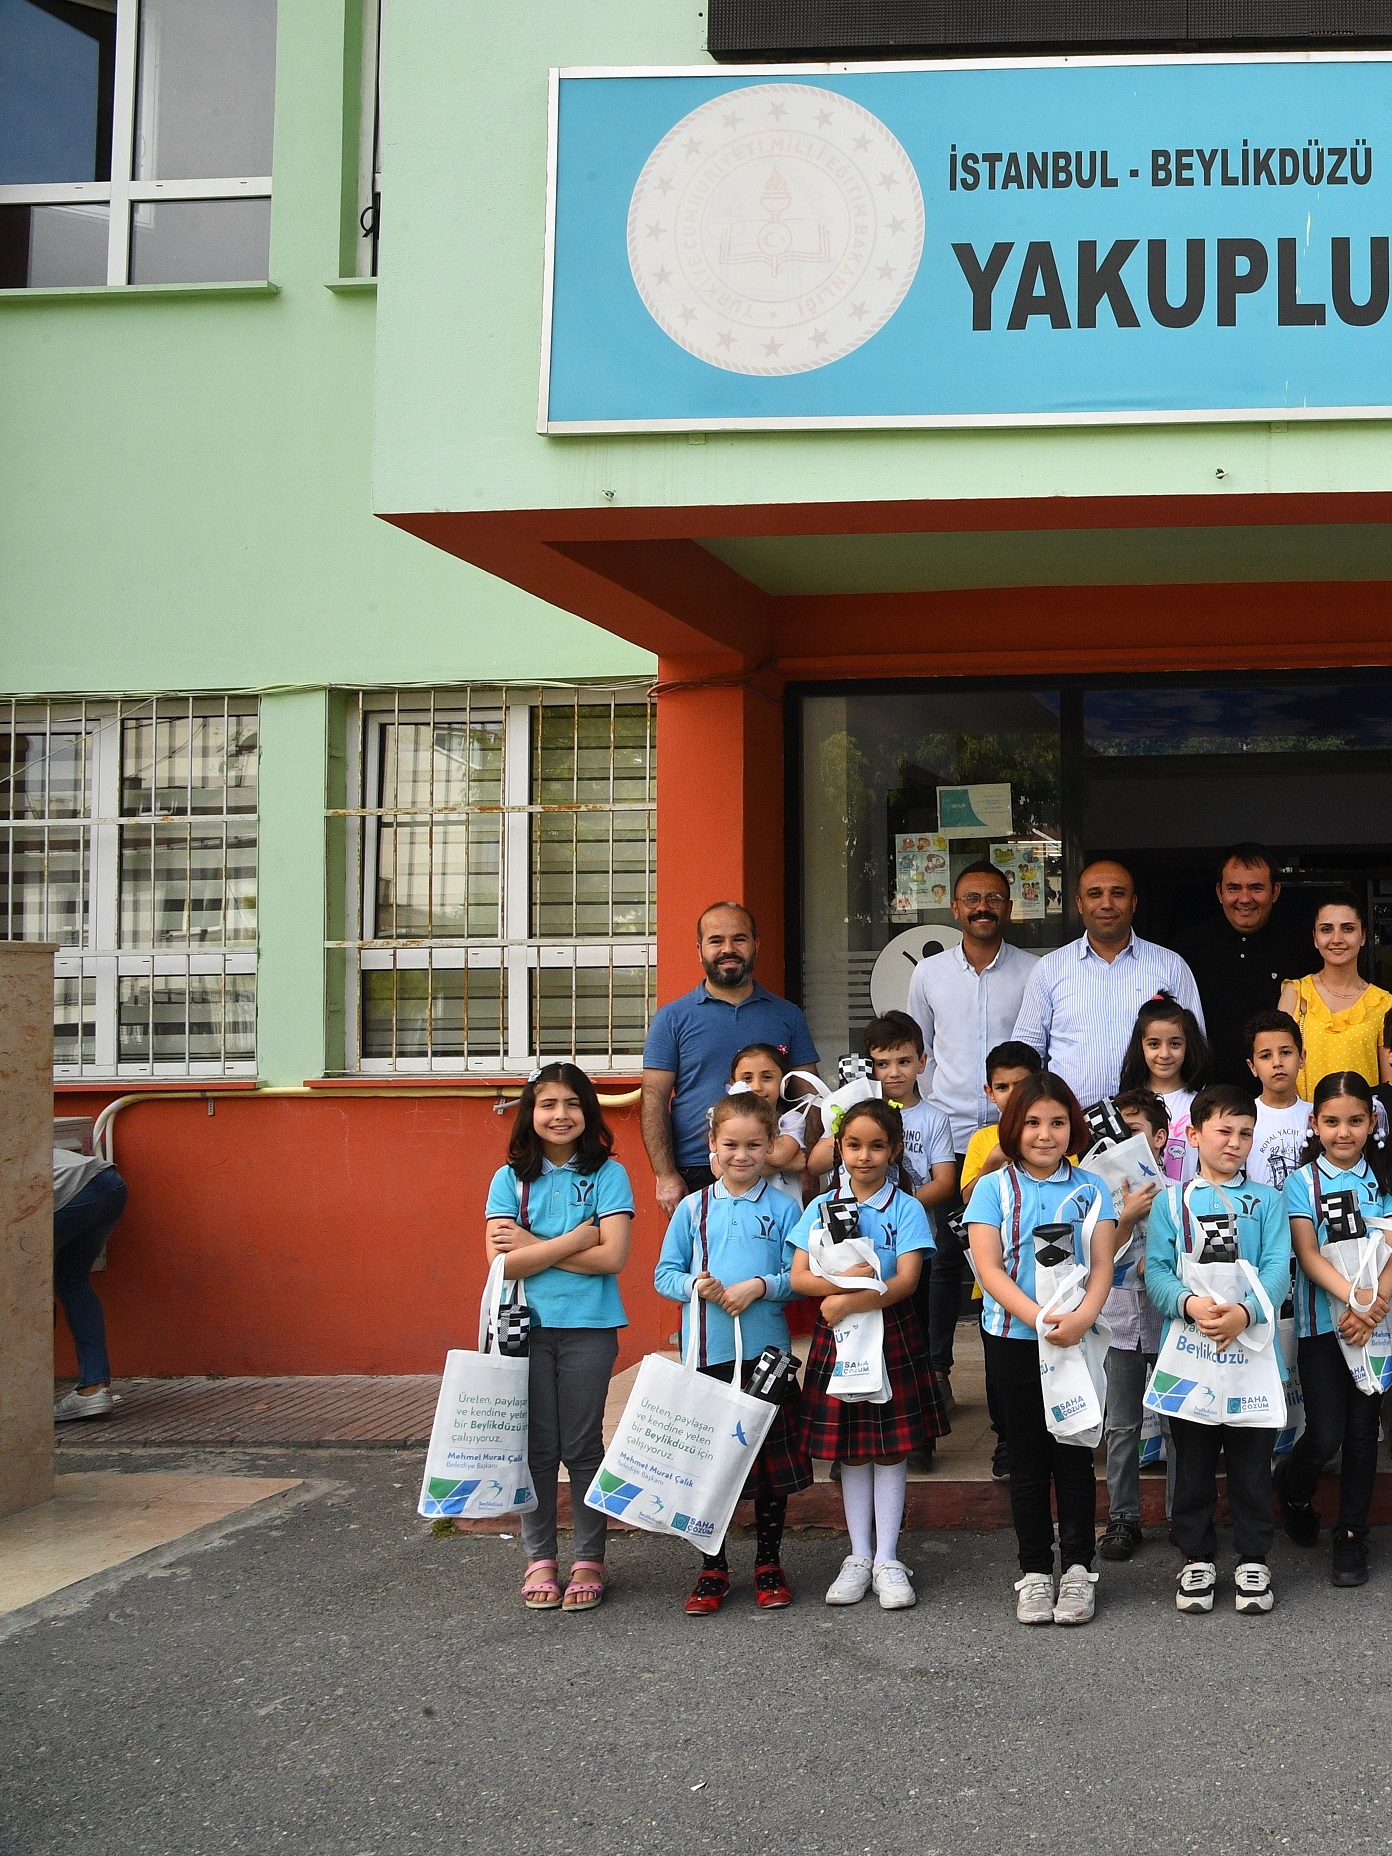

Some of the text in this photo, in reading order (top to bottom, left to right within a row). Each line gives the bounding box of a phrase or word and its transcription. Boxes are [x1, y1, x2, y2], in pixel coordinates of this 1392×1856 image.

[948, 144, 1118, 191] İSTANBUL
[1151, 138, 1373, 188] BEYLİKDÜZÜ
[951, 236, 1390, 332] YAKUPLU
[1259, 1128, 1300, 1153] ROYAL YACHT
[458, 1391, 492, 1404] Üreten,
[1060, 1395, 1085, 1410] SAHA
[1241, 1395, 1268, 1404] SAHA
[456, 1408, 468, 1416] ve
[470, 1407, 507, 1417] kendine
[640, 1397, 715, 1434] Üreten, paylaşan
[454, 1419, 468, 1429] bir
[470, 1420, 522, 1432] Beylikdüzü
[636, 1411, 712, 1446] ve kendine yeten
[451, 1432, 503, 1445] çalışıyoruz.
[631, 1421, 714, 1461] bir Beylikdüzü için
[626, 1435, 674, 1461] çalışıyoruz.
[447, 1451, 481, 1461] Mehmet
[483, 1452, 506, 1462] Murat
[446, 1462, 475, 1471] Belediye
[620, 1451, 694, 1488] Mehmet Murat Çalık
[689, 1517, 715, 1530] SAHA
